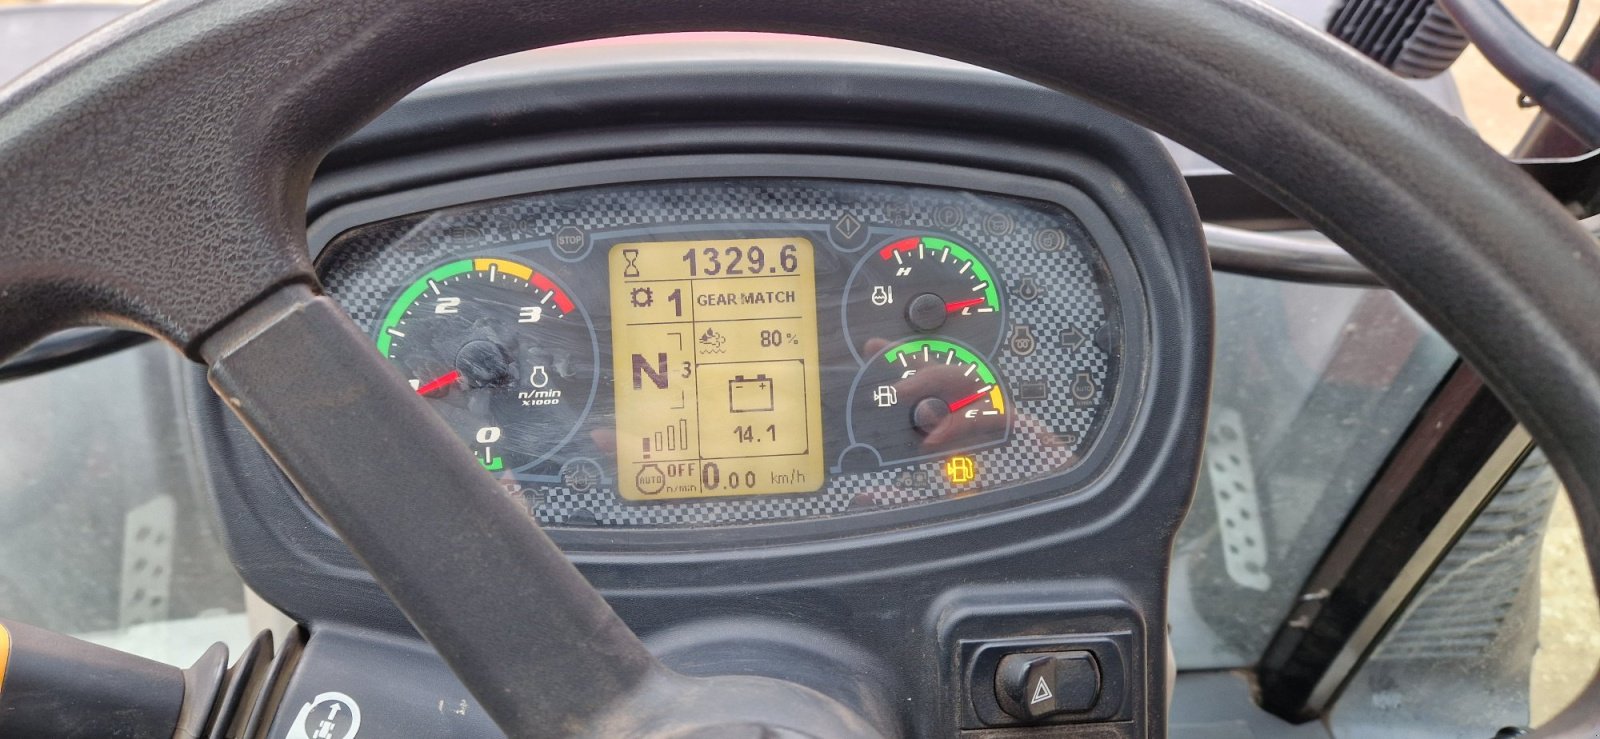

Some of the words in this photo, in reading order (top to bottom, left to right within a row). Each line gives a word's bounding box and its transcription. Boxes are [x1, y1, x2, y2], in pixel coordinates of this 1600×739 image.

[558, 235, 582, 246] STOP
[682, 244, 798, 277] 1329.6
[896, 267, 912, 277] H
[434, 297, 461, 314] 2
[667, 288, 682, 317] 1
[697, 293, 737, 306] GEAR
[740, 290, 796, 305] MATCH
[518, 306, 542, 323] 3
[760, 329, 783, 348] 80
[631, 352, 669, 391] N
[681, 361, 692, 378] 3
[901, 370, 917, 379] F
[518, 389, 562, 400] n/min
[964, 409, 979, 418] E
[476, 426, 501, 443] 0
[732, 424, 777, 444] 14.1
[667, 463, 696, 478] OFF
[702, 461, 756, 491] 0.00
[770, 468, 806, 486] km/h
[639, 475, 662, 485] AUTO
